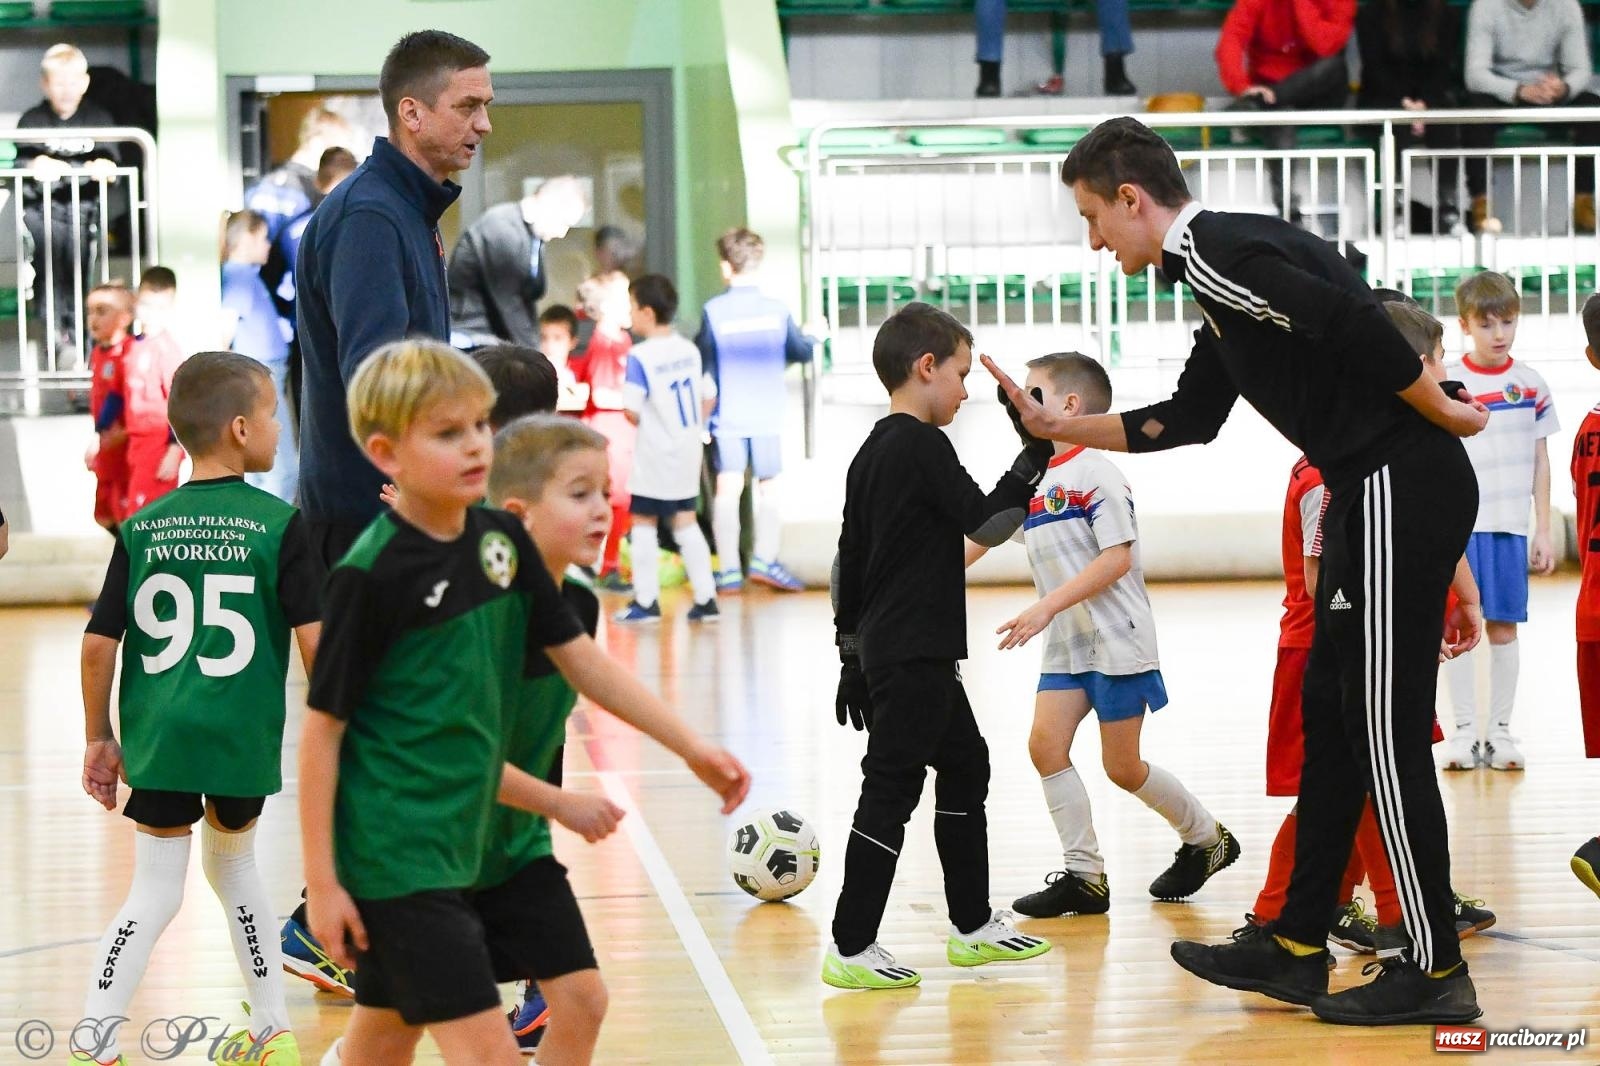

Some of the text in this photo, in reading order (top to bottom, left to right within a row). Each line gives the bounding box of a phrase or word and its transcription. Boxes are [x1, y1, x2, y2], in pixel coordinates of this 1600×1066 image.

[669, 377, 698, 428] 11
[132, 515, 267, 534] AKADEMIA PIŁKARSKA
[151, 528, 246, 542] MŁODEGO LKS-u
[144, 541, 252, 564] TWORKÓW
[133, 572, 256, 678] 95
[98, 919, 138, 991] TWORKÓW
[236, 905, 268, 979] TWORKÓW
